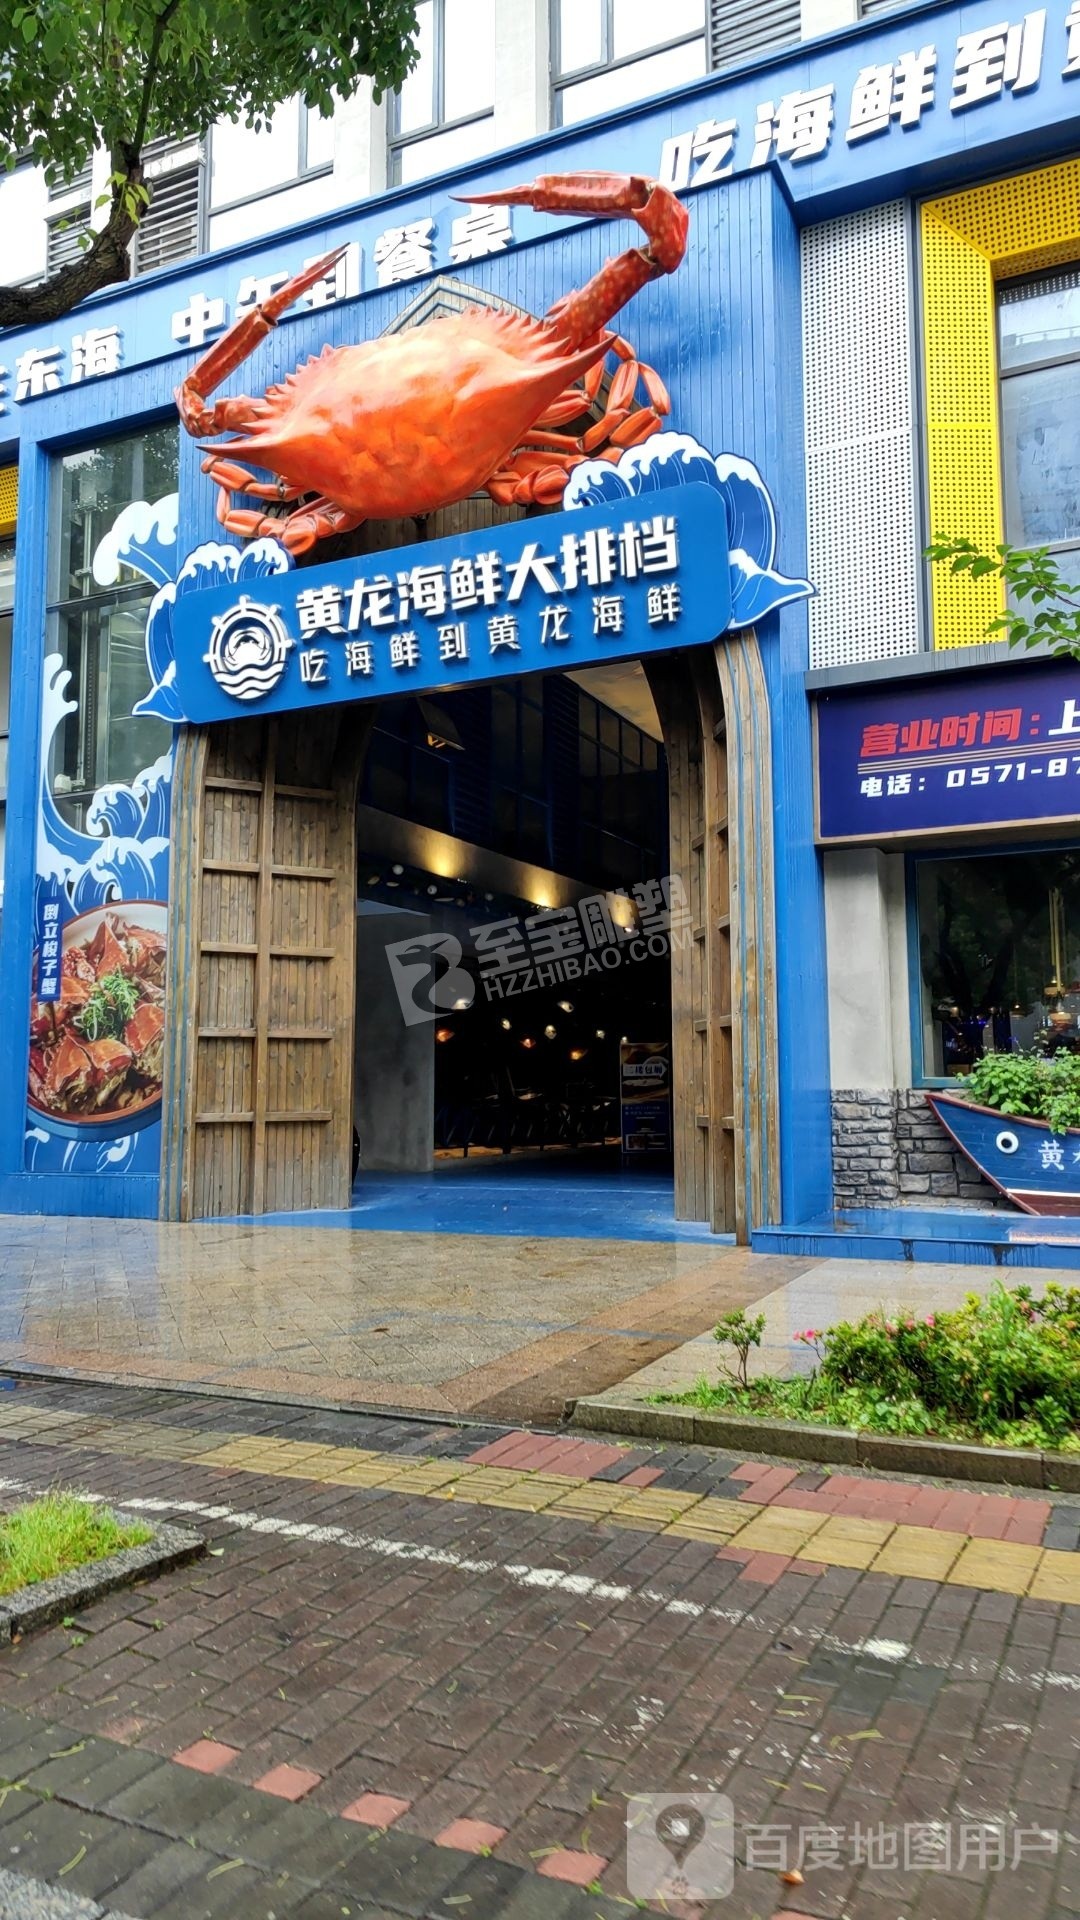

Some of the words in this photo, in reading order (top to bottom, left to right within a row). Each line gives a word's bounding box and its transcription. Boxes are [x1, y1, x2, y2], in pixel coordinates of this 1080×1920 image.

[0, 325, 120, 414] 东海
[296, 515, 680, 639] 黄龙海鲜大排档
[299, 583, 683, 684] 吃海鲜到黄龙海鲜
[41, 903, 60, 995] 倒立梭子蟹
